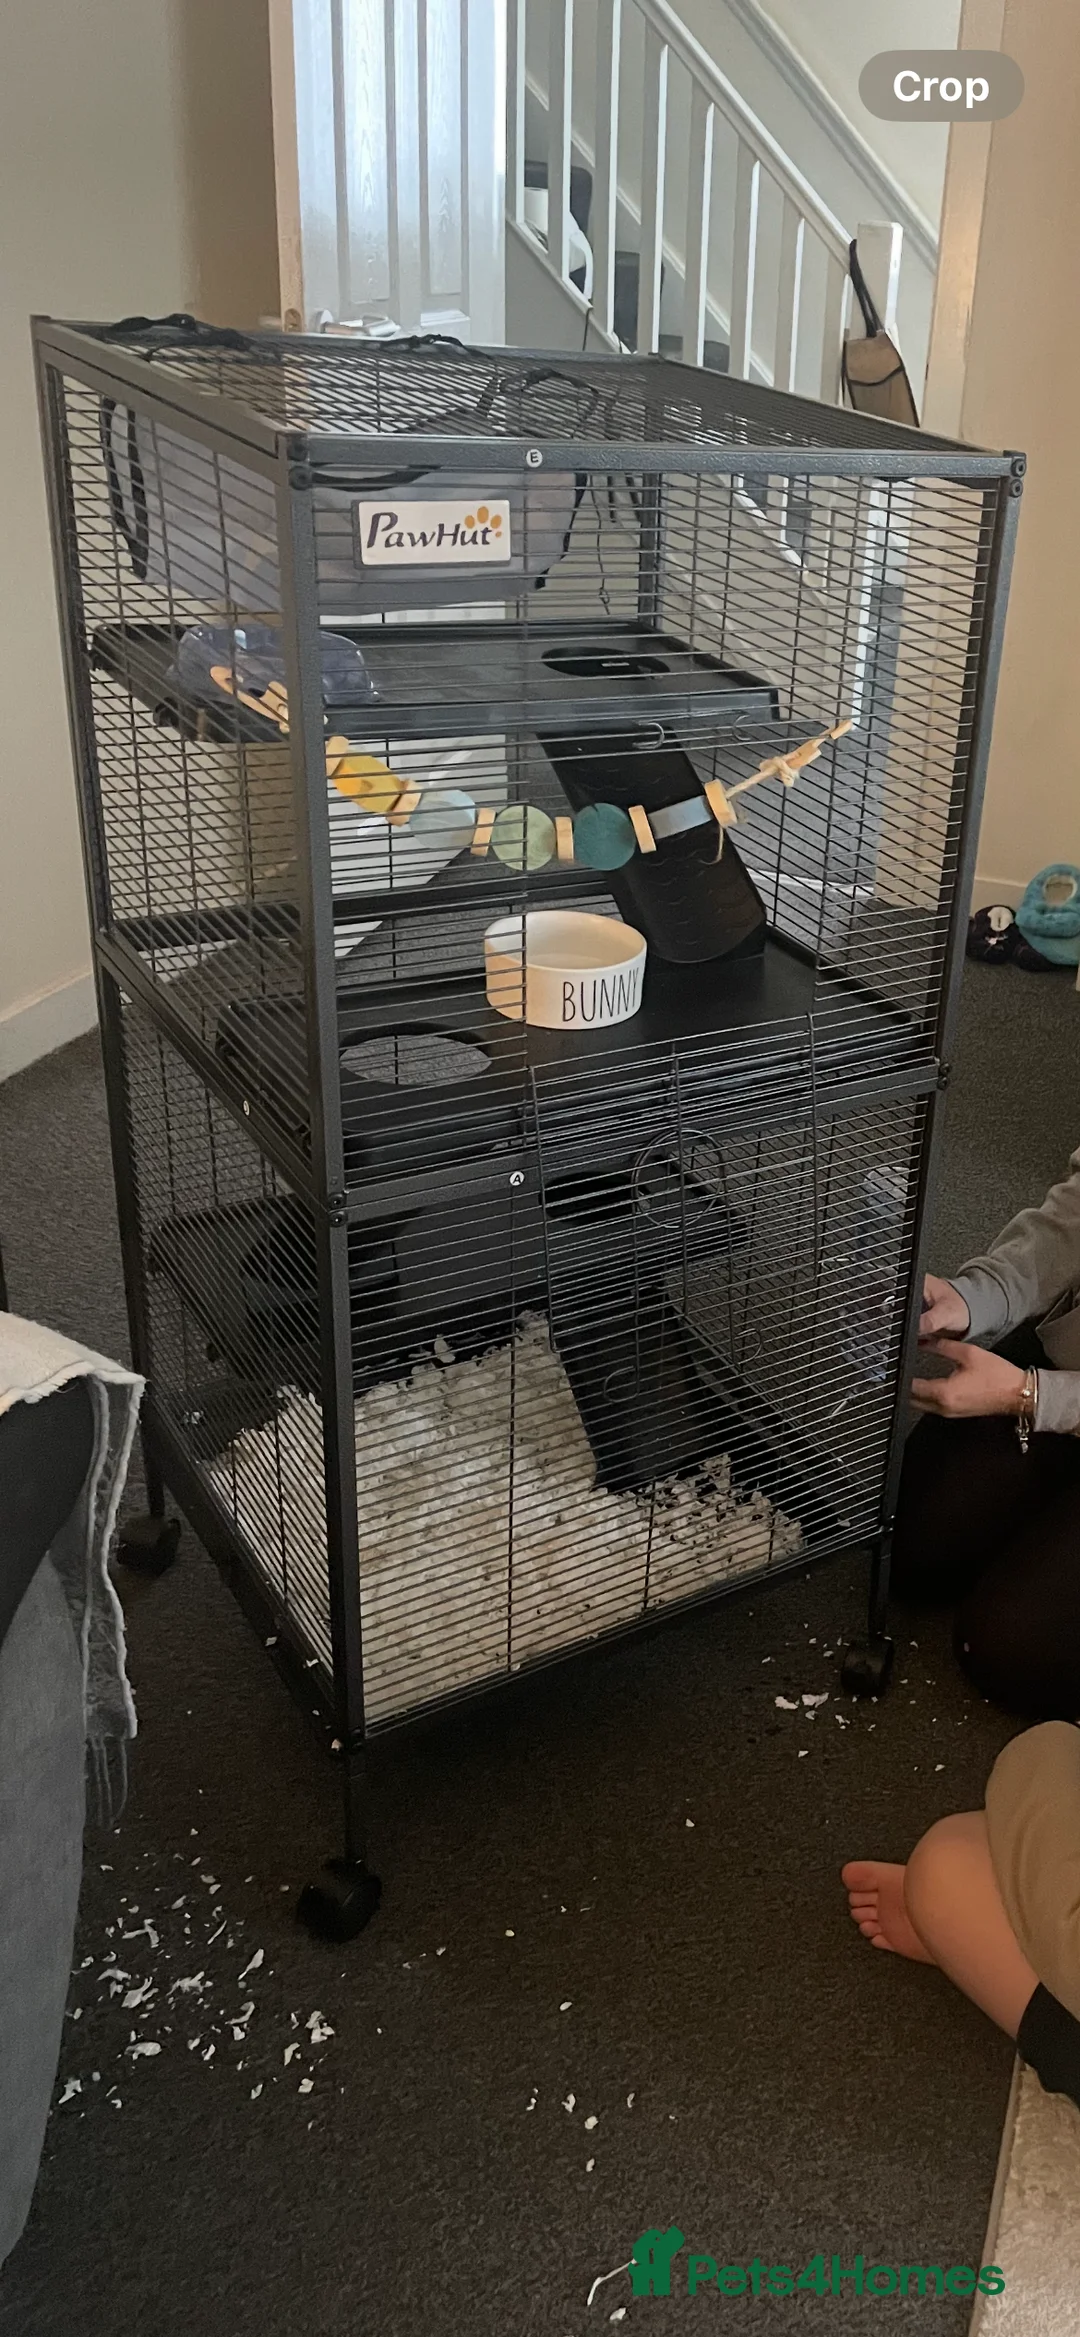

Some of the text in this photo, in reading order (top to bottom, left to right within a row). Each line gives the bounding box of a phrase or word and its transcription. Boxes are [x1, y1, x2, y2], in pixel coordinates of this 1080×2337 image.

[530, 451, 539, 463] E
[366, 511, 493, 549] PawHut
[562, 967, 640, 1022] BUNNY
